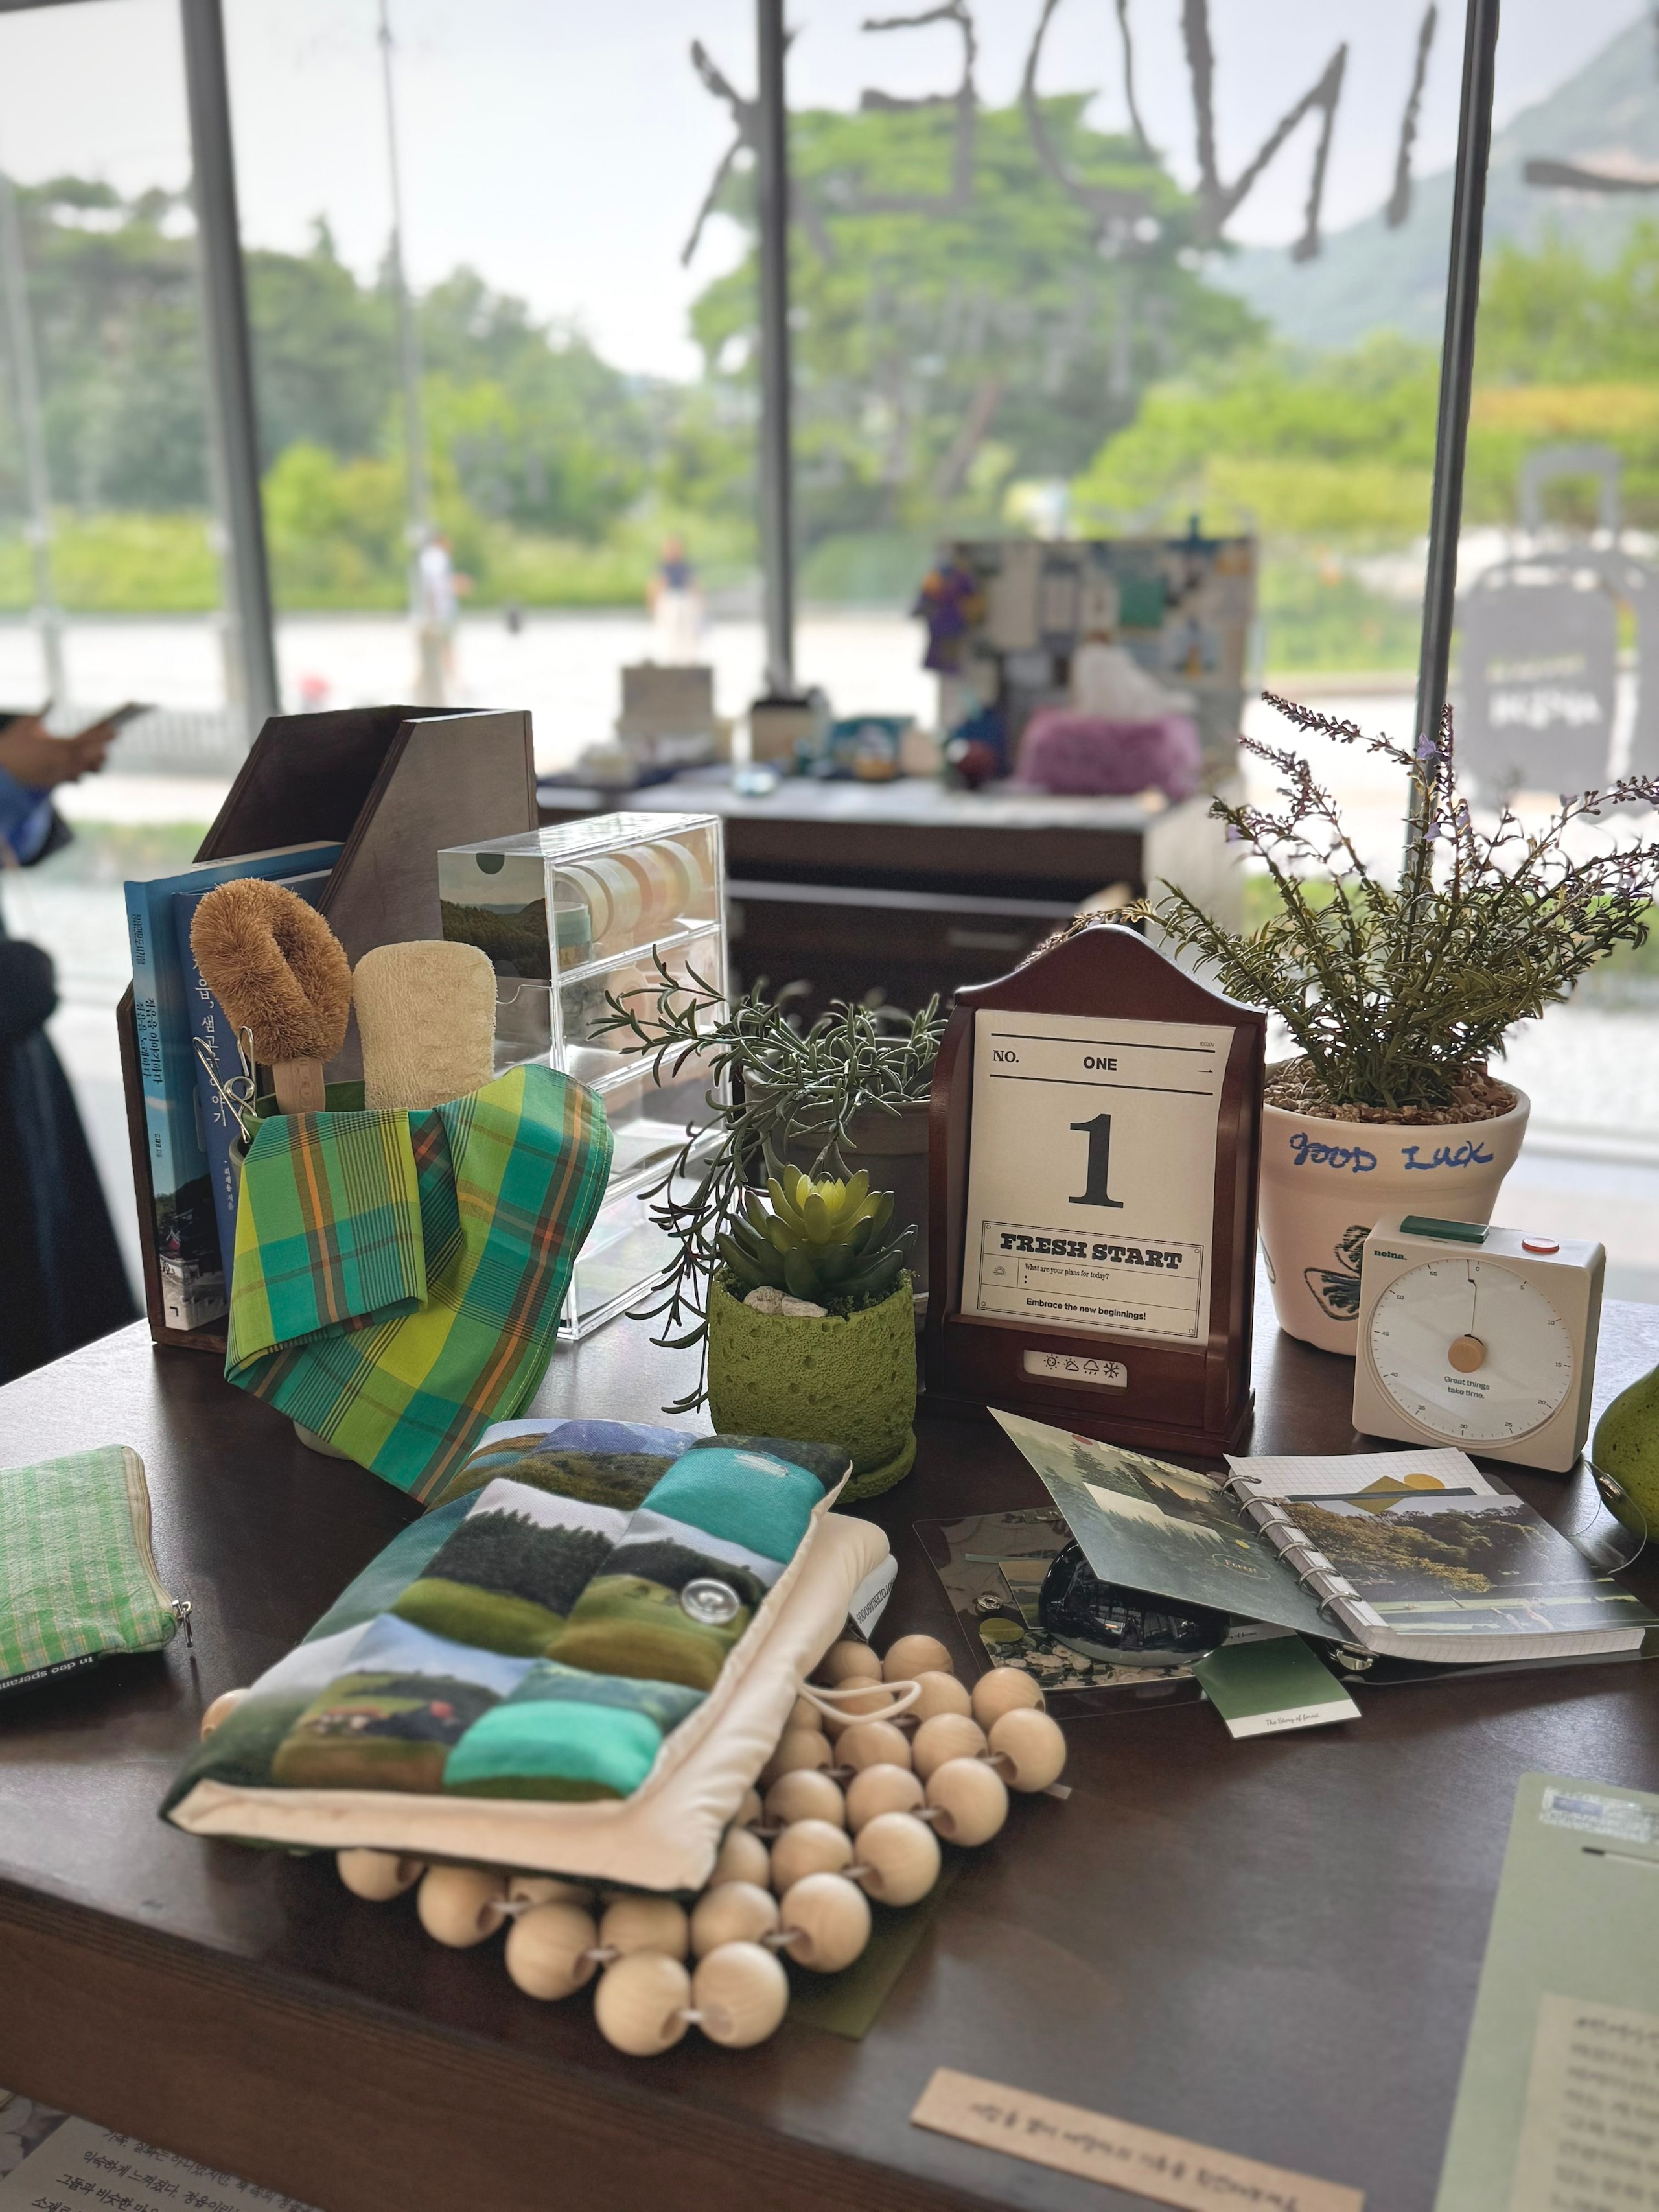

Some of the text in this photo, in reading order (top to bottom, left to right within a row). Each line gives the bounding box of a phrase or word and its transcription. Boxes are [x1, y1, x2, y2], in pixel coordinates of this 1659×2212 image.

[149, 1032, 163, 1084] 이야기하다
[992, 1050, 1118, 1071] NO. ONE
[1068, 1113, 1124, 1209] 1
[1000, 1232, 1183, 1269] FRESH START
[1025, 1263, 1039, 1272] What
[1064, 1268, 1080, 1277] plans
[1080, 1270, 1089, 1278] for
[1090, 1271, 1109, 1281] today?
[1026, 1298, 1063, 1309] Embrace
[1064, 1302, 1078, 1311] the
[1098, 1307, 1146, 1320] beginnings!
[1444, 1375, 1491, 1390] Great things
[1447, 1386, 1485, 1399] take time.
[1224, 1559, 1257, 1574] Forest
[51, 1662, 76, 1674] deo
[79, 1655, 93, 1664] In
[1295, 1714, 1302, 1723] of
[56, 2173, 97, 2196] 그들과
[95, 2187, 135, 2211] 비슷한
[127, 2169, 181, 2198] 느껴졌다.
[183, 2190, 239, 2212] 정읍이라
